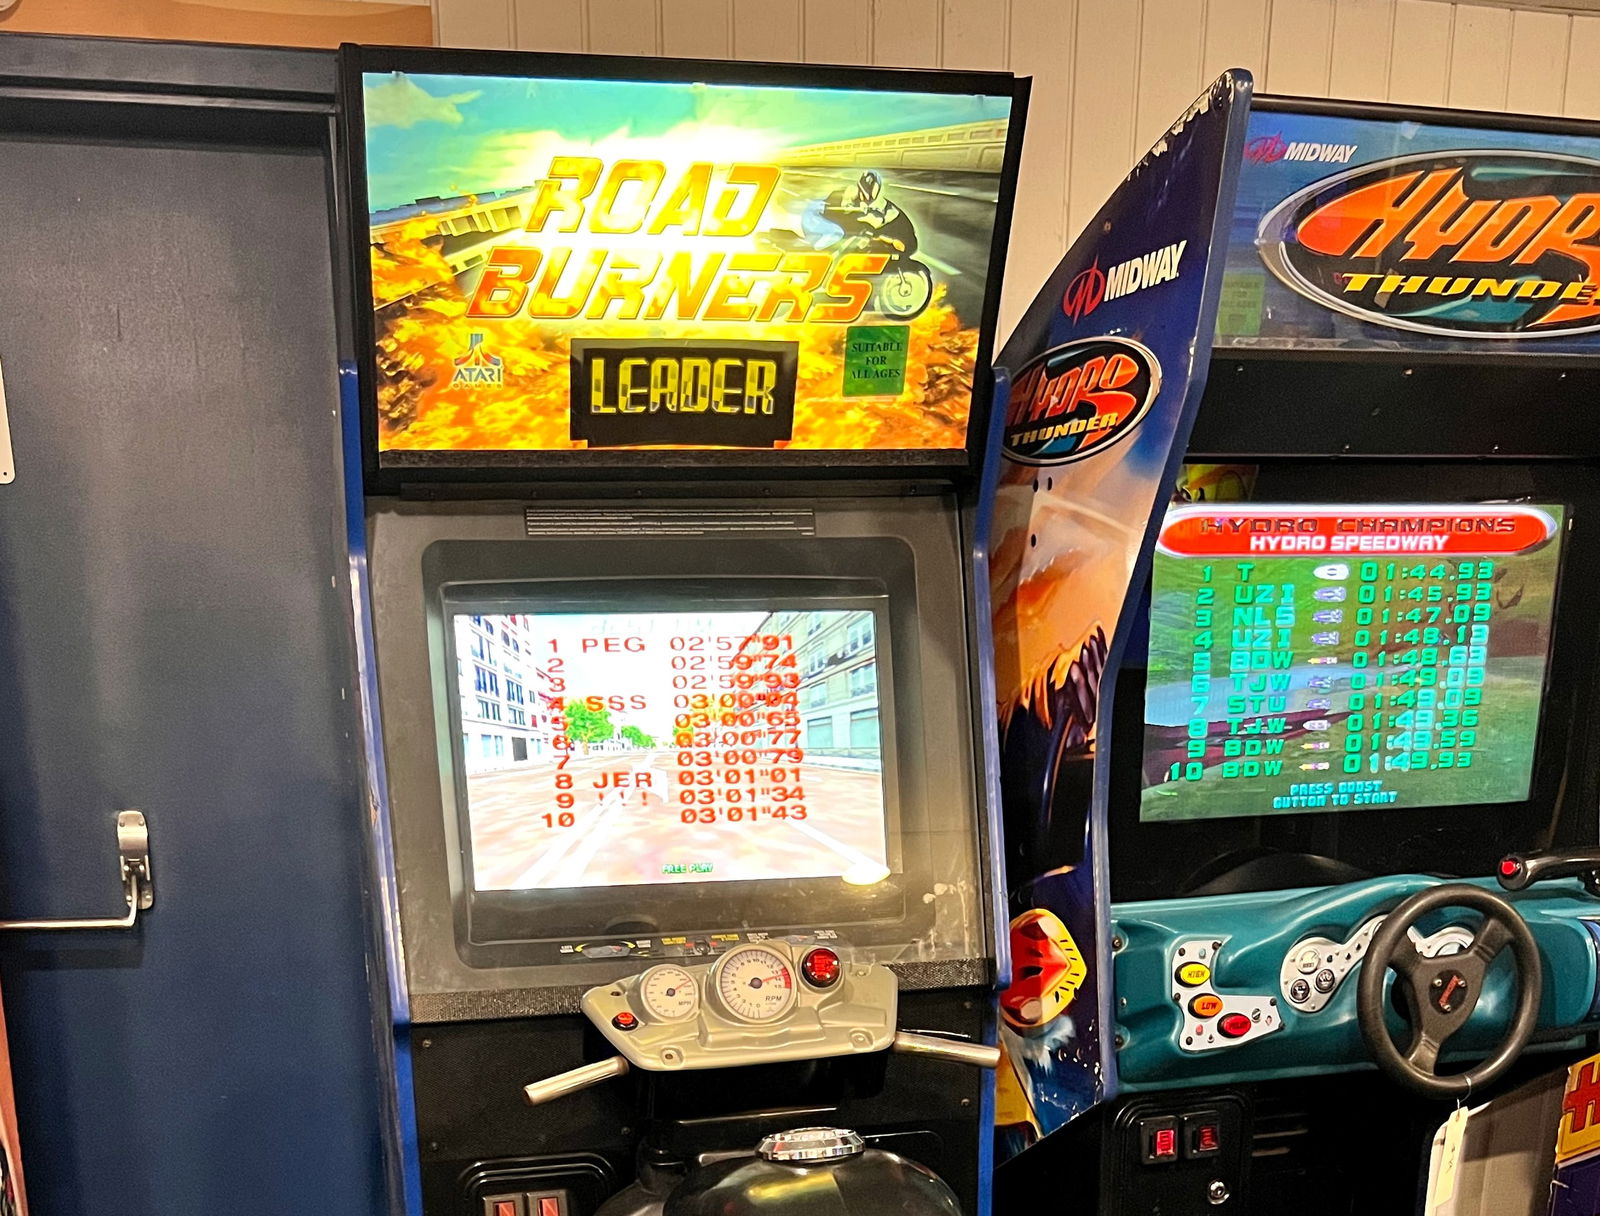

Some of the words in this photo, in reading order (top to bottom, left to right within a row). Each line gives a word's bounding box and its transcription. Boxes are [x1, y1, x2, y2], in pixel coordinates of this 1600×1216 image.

[1283, 142, 1358, 164] MIDWAY
[525, 156, 782, 237] ROAD
[1104, 240, 1188, 302] MIDWAY
[466, 246, 889, 323] BURNERS
[1342, 272, 1600, 302] THUNDE
[851, 342, 903, 353] SUITABLE
[866, 356, 887, 365] FOR
[453, 367, 501, 382] ATARI
[852, 369, 870, 379] ALL
[872, 368, 901, 379] AGES
[590, 357, 777, 415] LEADER
[1004, 353, 1139, 427] HYDRO
[1011, 412, 1119, 447] THUNDER
[1201, 517, 1317, 534] HYDRO
[1336, 517, 1515, 533] CHAMPIONS
[1250, 535, 1326, 551] HYDRO
[1330, 534, 1448, 551] SPEEDWAY
[1203, 565, 1213, 582] 1
[1237, 563, 1255, 582] T
[1196, 587, 1214, 605] 2
[1234, 584, 1295, 604] UZI
[1195, 609, 1212, 627] 3
[1233, 606, 1295, 627] NLS
[547, 638, 558, 653] 1
[582, 637, 645, 653] PEG
[1193, 630, 1213, 649] 4
[1231, 628, 1291, 649] UZI
[547, 657, 564, 673] 2
[1192, 652, 1211, 672] 5
[549, 677, 566, 692] 3
[1191, 673, 1210, 693] 6
[1229, 673, 1291, 692] TJW
[586, 695, 646, 712] SSS
[1190, 696, 1208, 715] 7
[1227, 694, 1286, 714] STU
[1188, 718, 1208, 738] 8
[1226, 718, 1286, 734] TJW
[1187, 740, 1206, 758] 9
[553, 755, 571, 770] 7
[1170, 761, 1203, 780] 10
[555, 774, 573, 789] 8
[593, 772, 652, 788] JER
[1290, 782, 1335, 796] PRESS
[1338, 779, 1383, 793] BOOST
[556, 793, 575, 808] 9
[1273, 795, 1327, 809] BUTTON
[1331, 793, 1350, 806] TO
[1353, 790, 1398, 805] START
[541, 812, 575, 828] 10
[690, 862, 713, 873] PLAY
[1201, 1002, 1217, 1010] LOW
